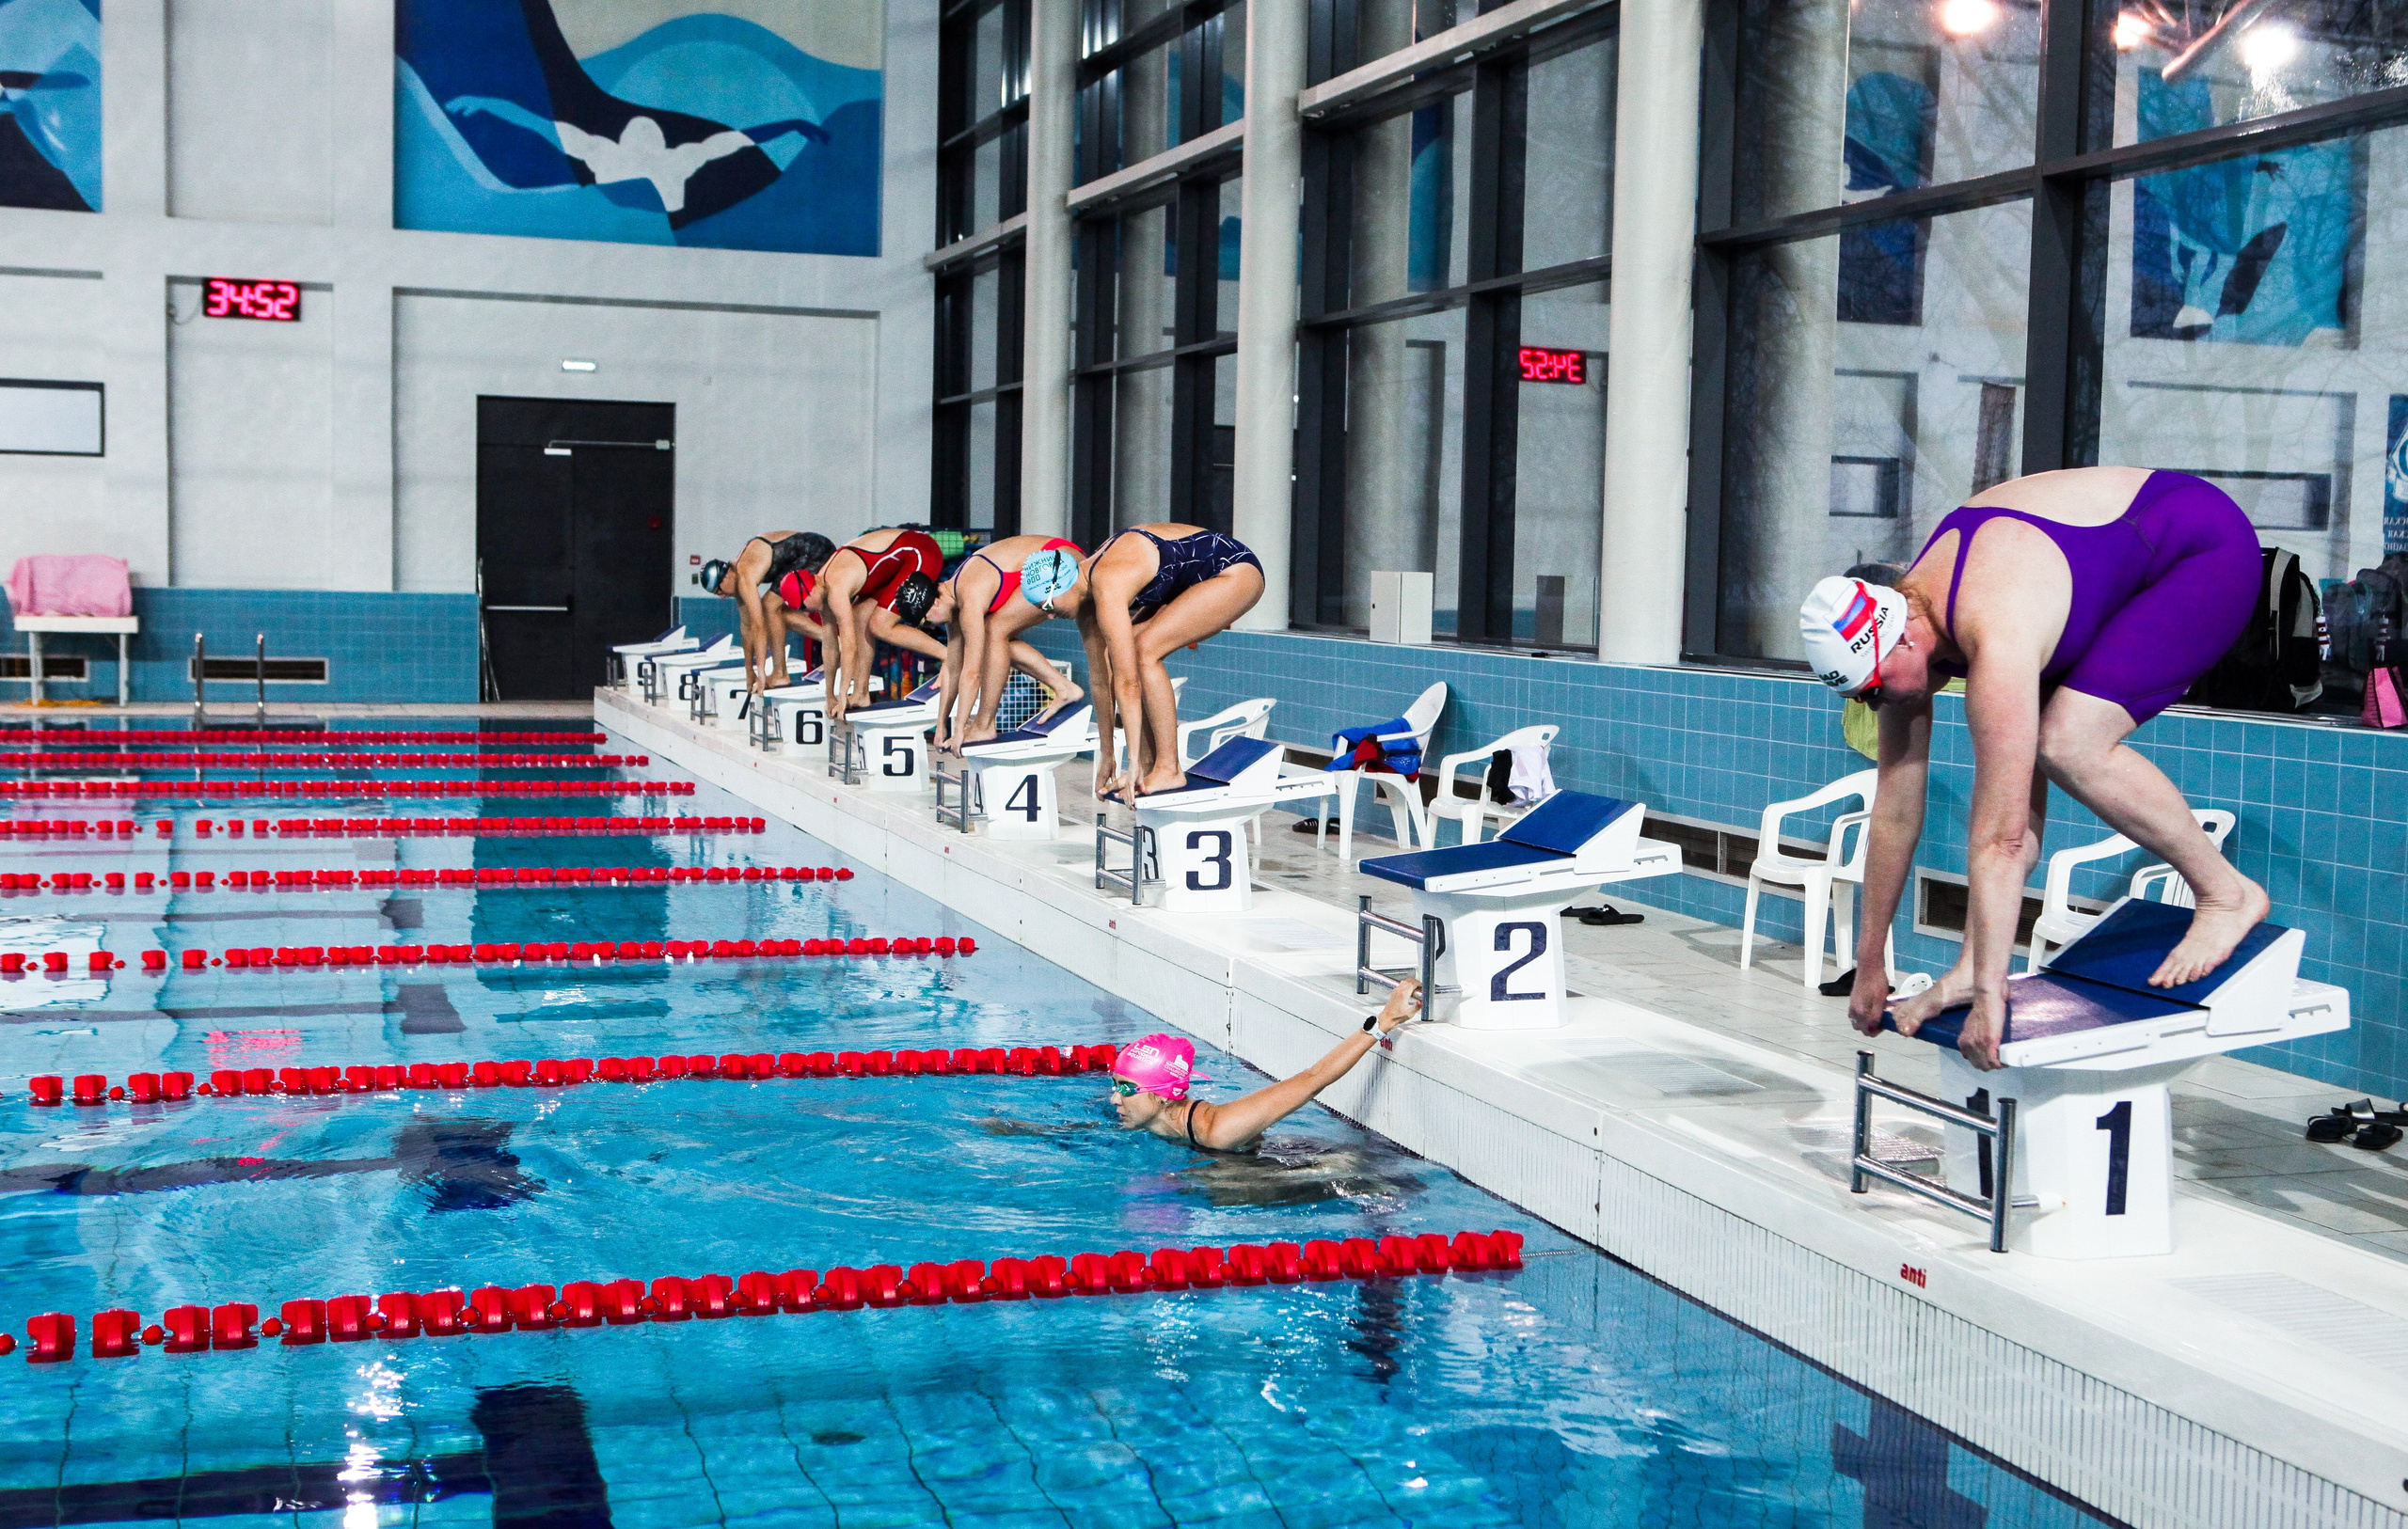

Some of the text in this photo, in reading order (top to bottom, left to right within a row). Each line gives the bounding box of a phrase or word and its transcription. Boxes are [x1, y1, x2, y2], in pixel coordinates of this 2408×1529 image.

[207, 280, 299, 320] 34:52
[1024, 555, 1055, 571] НИЖНИ
[1025, 560, 1064, 578] НОВГОР
[678, 673, 700, 701] 8
[729, 689, 752, 720] 7
[795, 710, 823, 745] 6
[882, 736, 914, 777] 5
[1005, 774, 1042, 823] 4
[1185, 830, 1232, 891] 3
[1490, 921, 1547, 1002] 2
[2096, 1100, 2132, 1216] 1
[1900, 1263, 1926, 1289] anti
